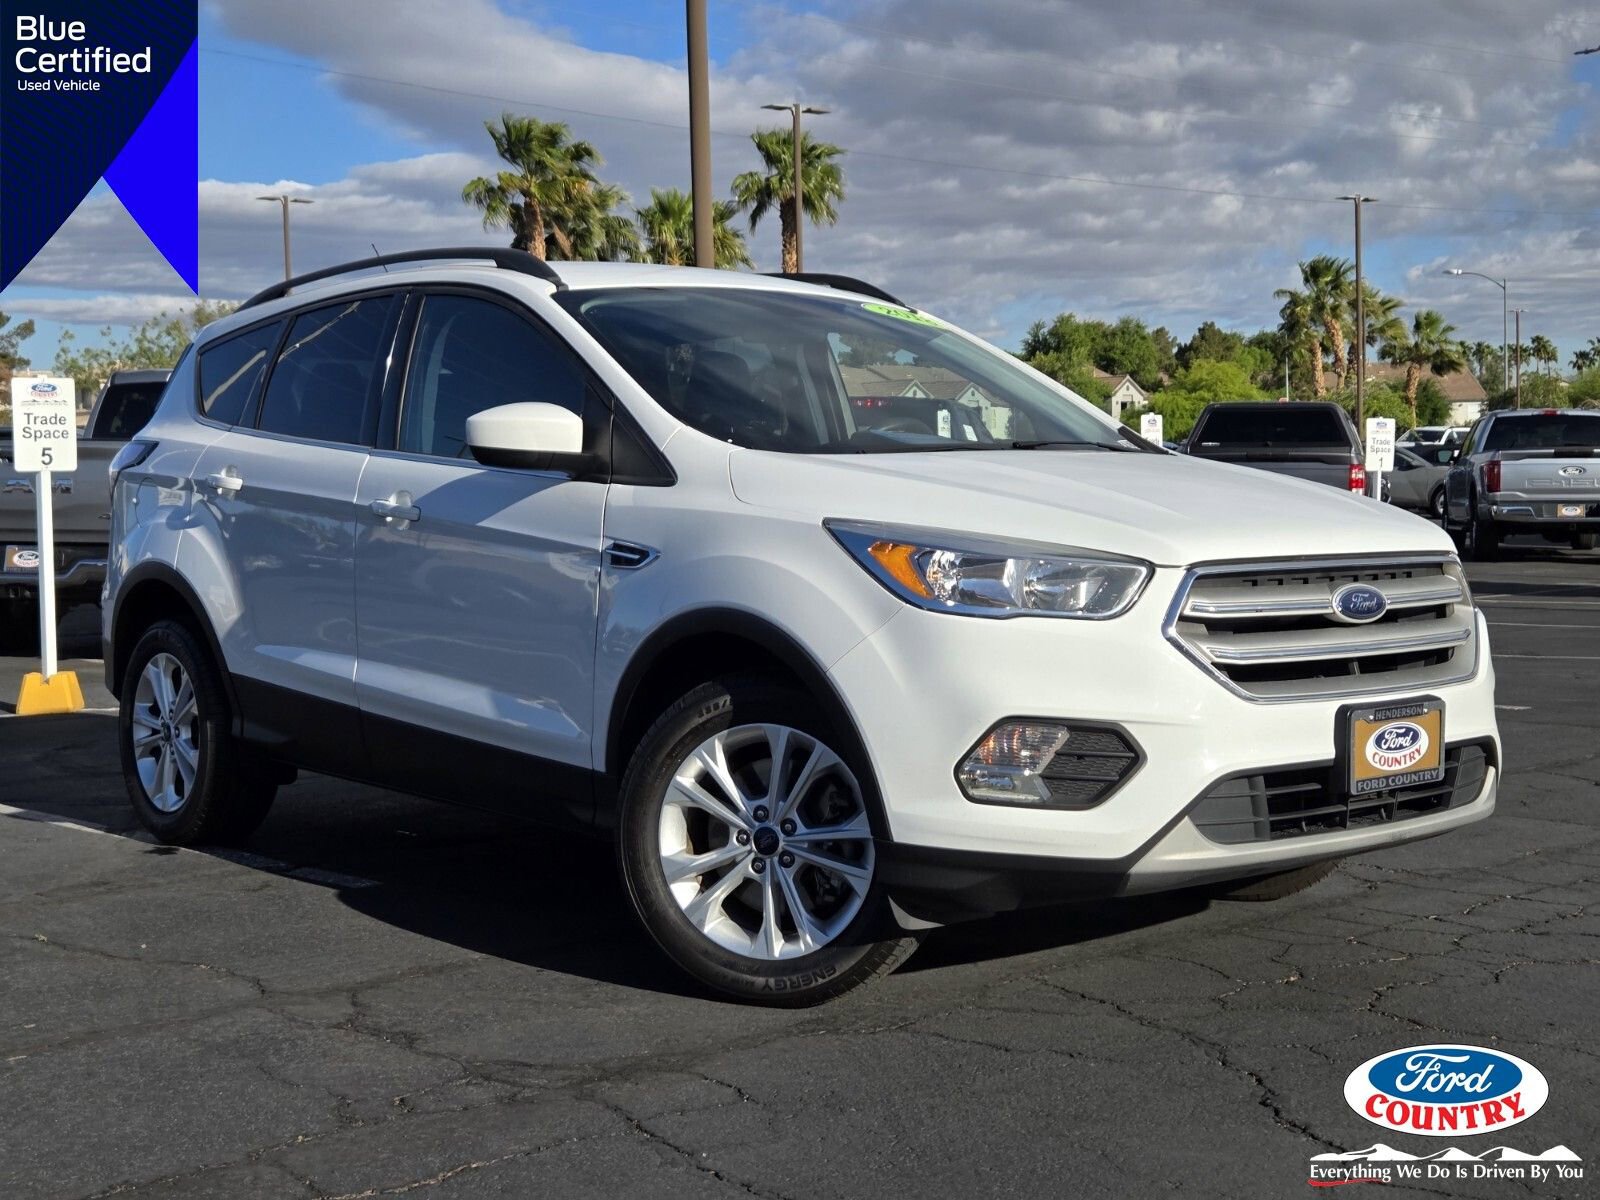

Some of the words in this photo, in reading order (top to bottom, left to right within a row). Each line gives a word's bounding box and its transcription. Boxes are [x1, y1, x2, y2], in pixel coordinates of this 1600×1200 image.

[24, 412, 67, 425] Trade
[22, 426, 69, 442] Space
[1372, 437, 1391, 446] Trade
[41, 447, 53, 466] 5
[1370, 445, 1391, 454] Space
[1350, 593, 1377, 610] Ford
[1375, 706, 1423, 719] HENDERSON
[1381, 728, 1413, 749] Ford
[1372, 745, 1421, 767] COUNTRY
[1357, 779, 1387, 791] FORD
[1388, 769, 1439, 786] COUNTRY
